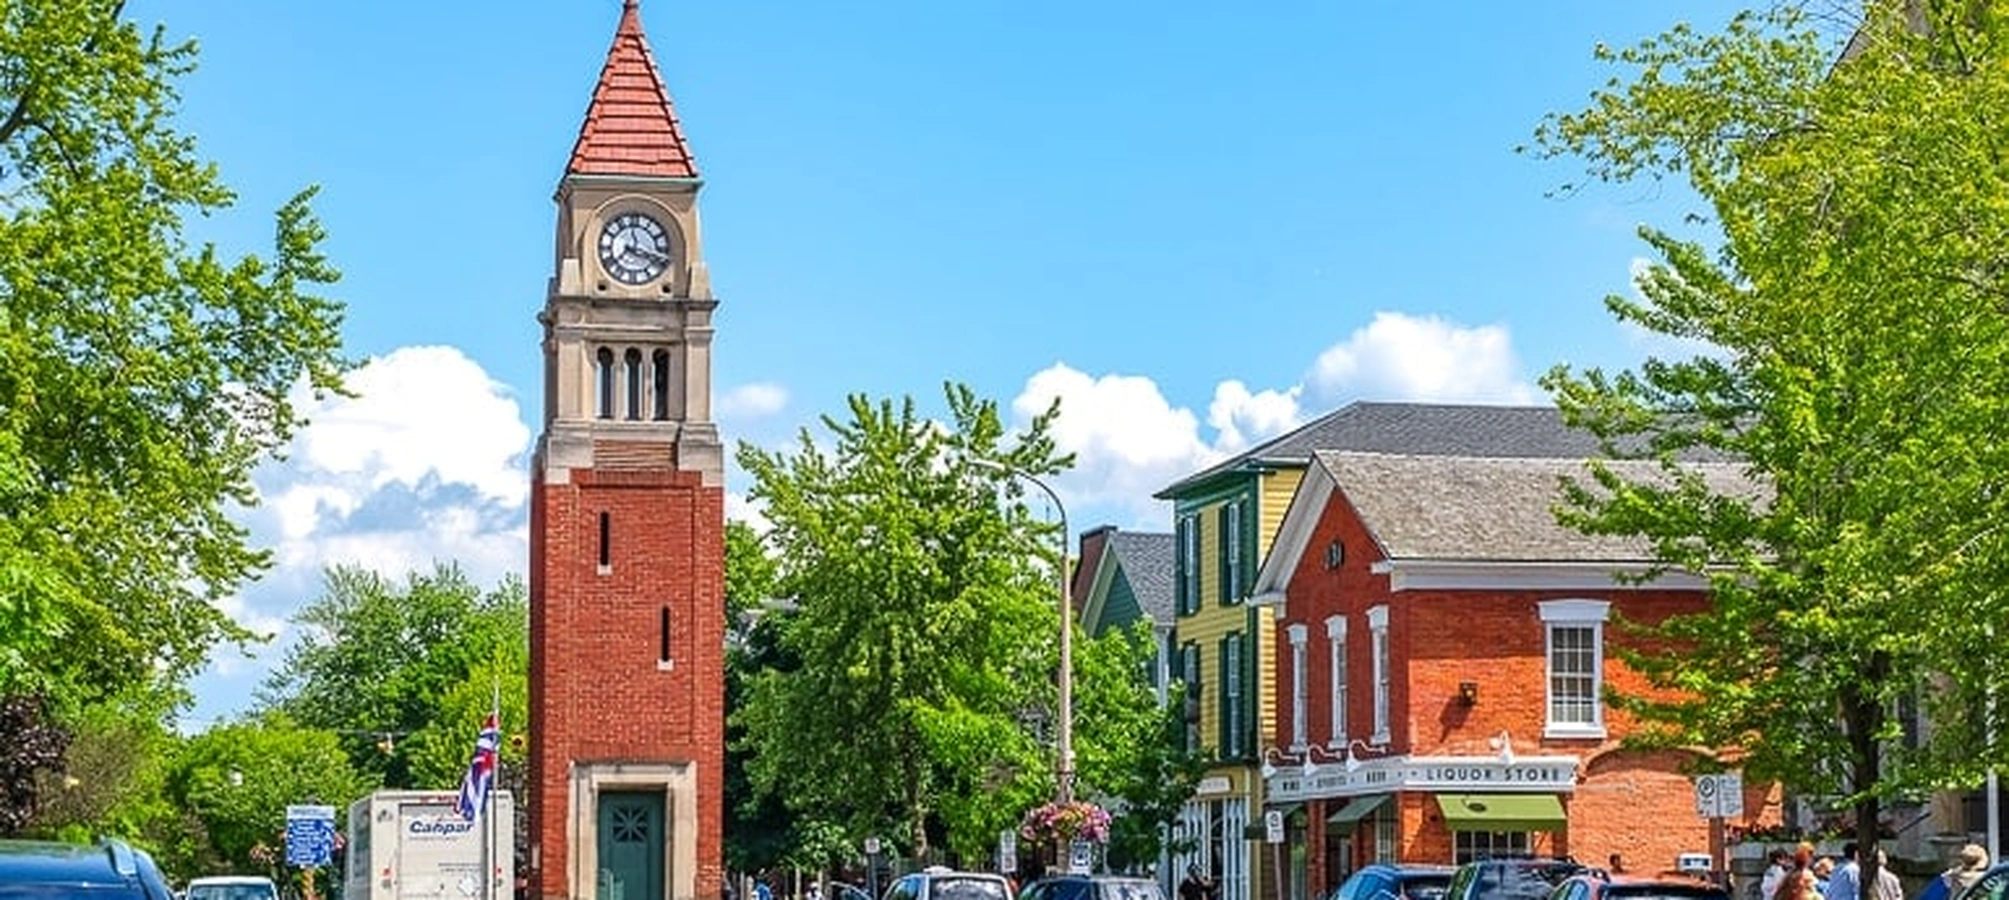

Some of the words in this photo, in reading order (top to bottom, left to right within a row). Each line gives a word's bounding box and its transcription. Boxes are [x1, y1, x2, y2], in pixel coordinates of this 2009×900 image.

[1426, 768, 1491, 781] LIQUOR
[1504, 768, 1559, 781] STORE
[409, 820, 474, 835] Canpar
